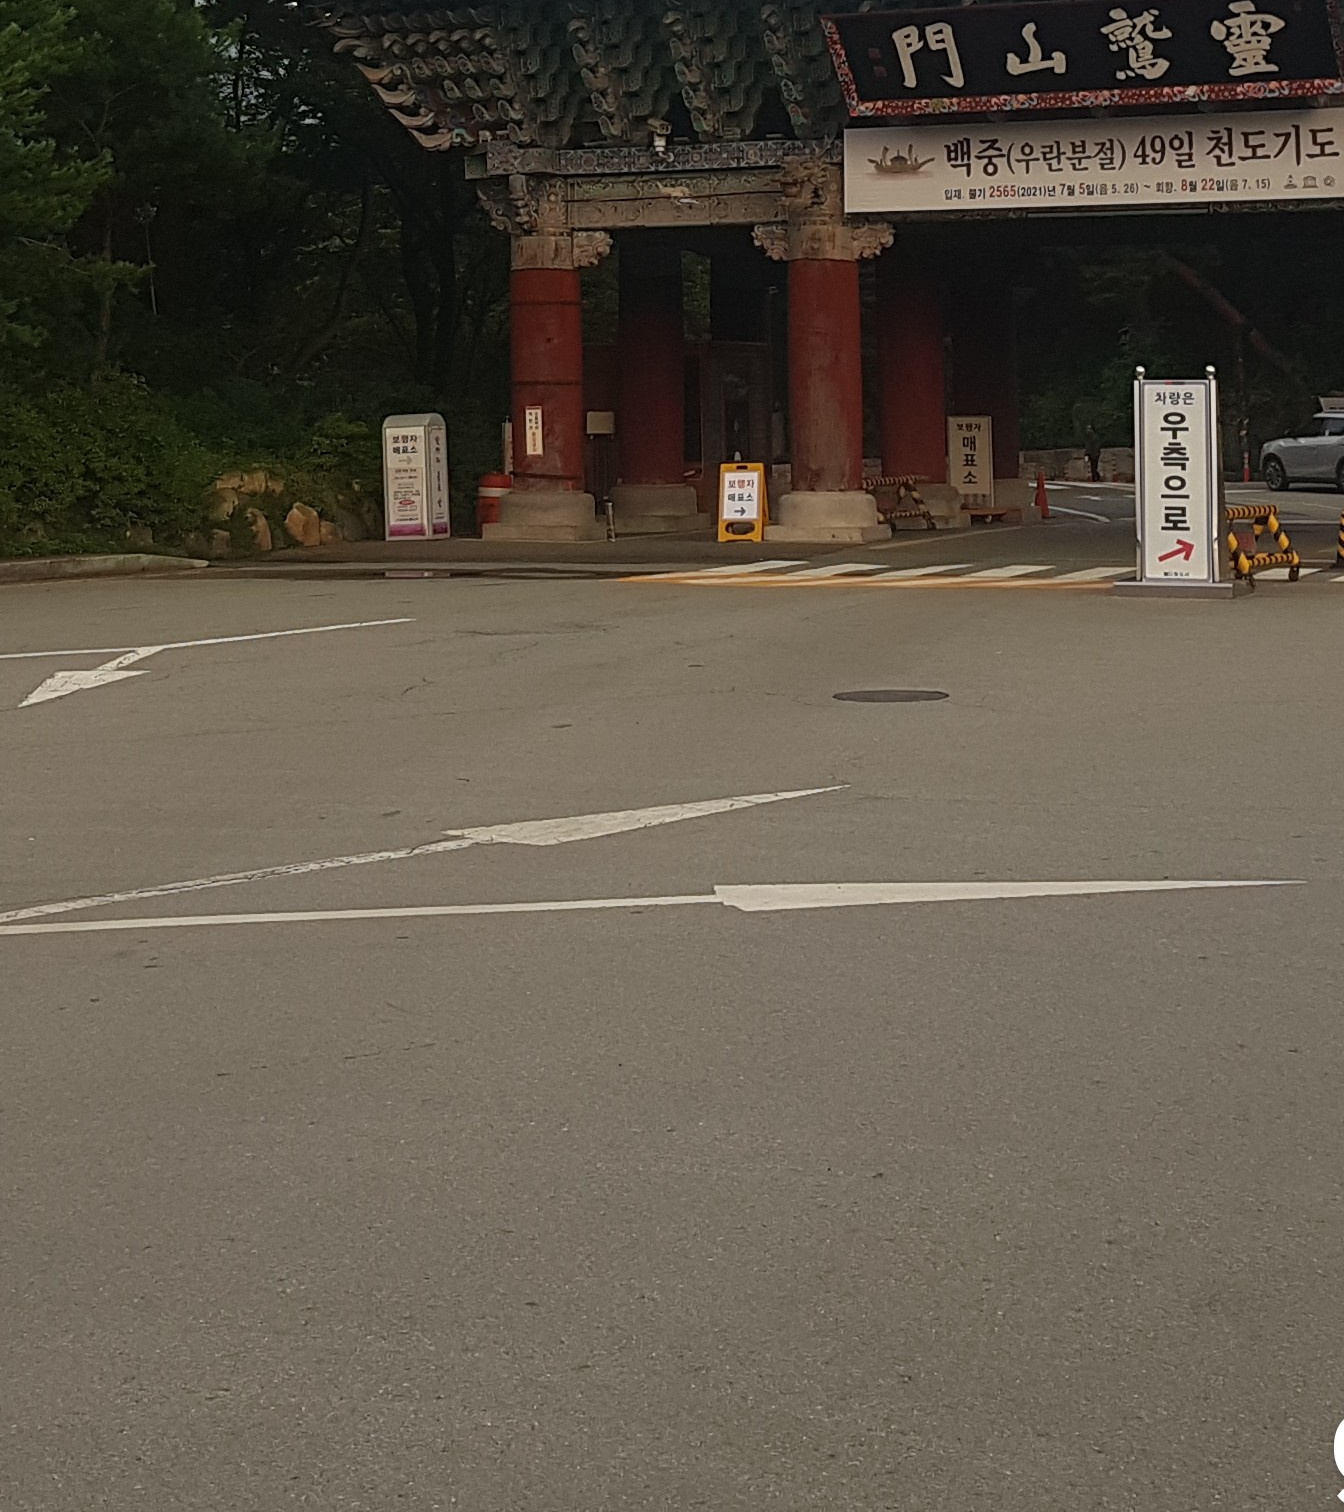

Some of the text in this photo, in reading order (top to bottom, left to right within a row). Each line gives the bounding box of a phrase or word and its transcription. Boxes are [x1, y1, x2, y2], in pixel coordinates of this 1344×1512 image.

[943, 124, 1340, 178] 백중(우란분절) 49일 천도기도
[988, 185, 1056, 199] 2565(2021)년
[1059, 183, 1075, 196] 7월
[1181, 179, 1197, 193] 8월
[1154, 391, 1195, 406] 차량은
[956, 422, 982, 433] 보행자
[392, 434, 418, 444] 보행자
[392, 445, 418, 455] 매표소
[962, 435, 978, 485] 매표소
[1160, 411, 1191, 532] 우측으로
[728, 479, 755, 489] 보행자
[727, 492, 754, 502] 매표소
